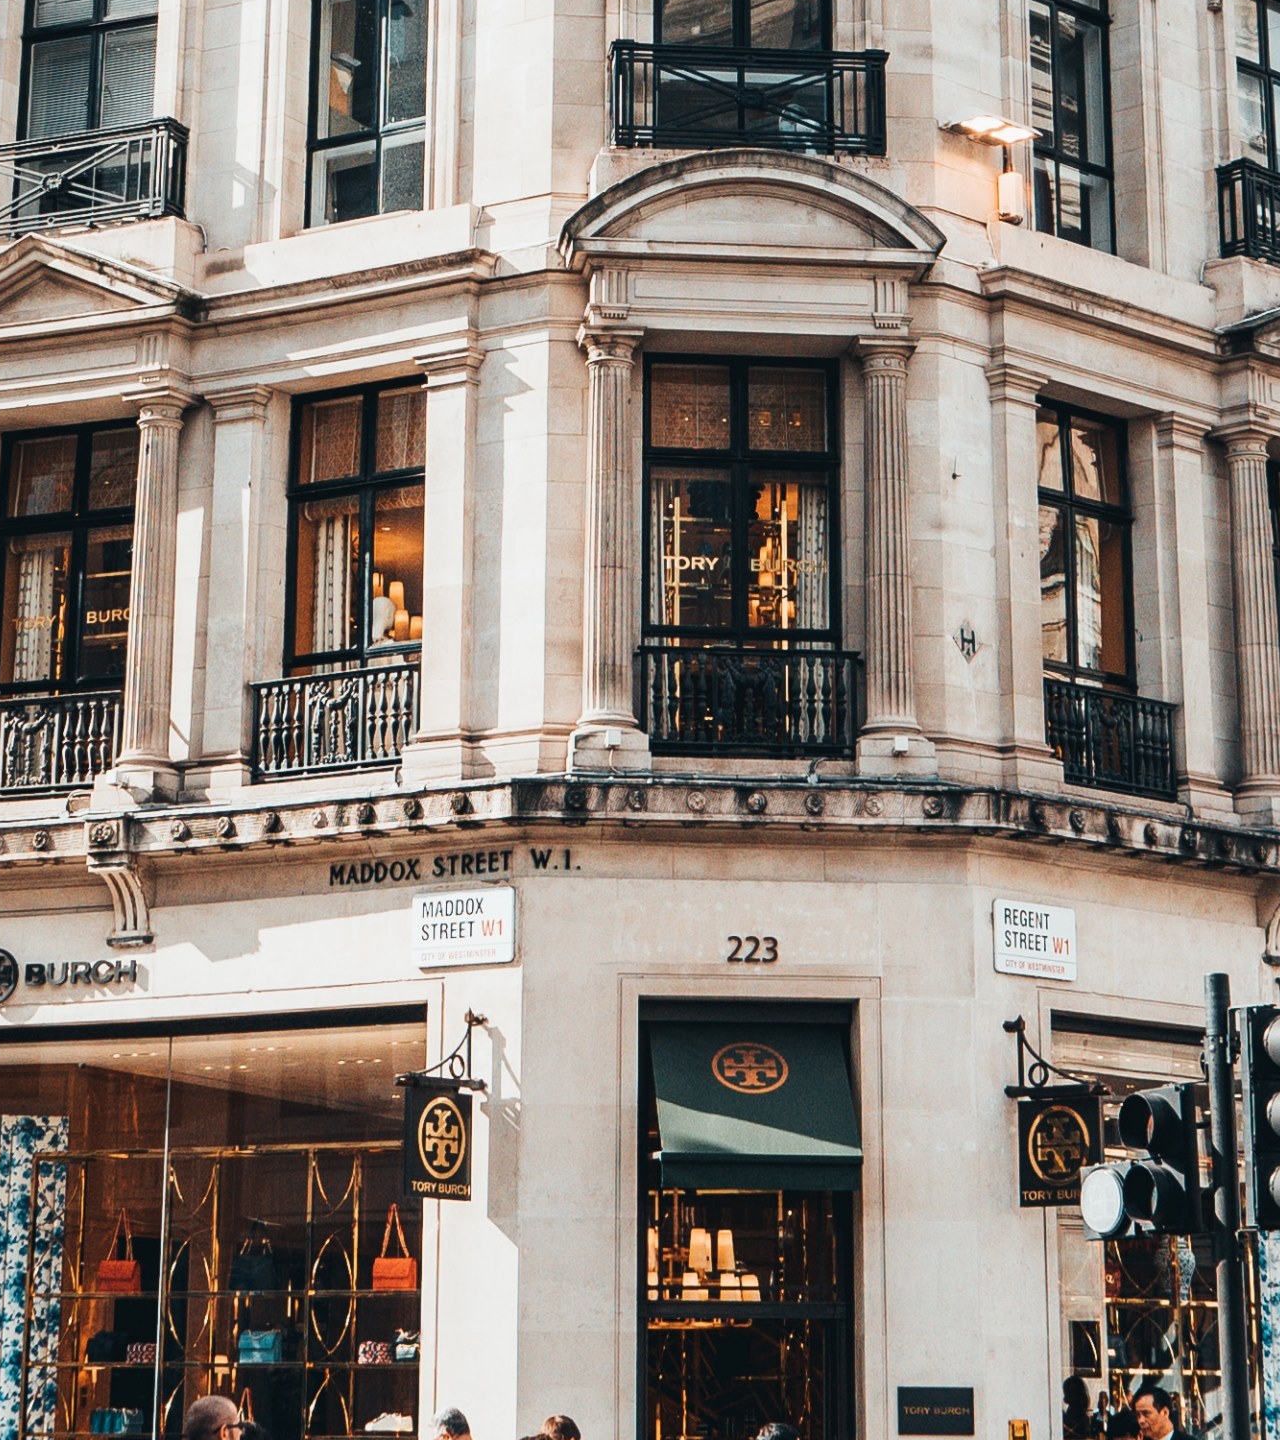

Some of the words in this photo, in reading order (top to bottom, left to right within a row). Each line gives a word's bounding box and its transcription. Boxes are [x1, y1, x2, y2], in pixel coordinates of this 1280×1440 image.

[660, 555, 719, 570] TORY
[86, 607, 131, 624] BURC
[329, 858, 420, 886] MADDOX
[432, 850, 513, 878] STREET
[422, 897, 484, 919] MADDOX
[1004, 907, 1050, 930] REGENT
[421, 920, 475, 941] STREET
[481, 919, 504, 937] W1
[727, 935, 779, 963] 223
[1004, 929, 1048, 952] STREET
[1052, 935, 1070, 955] W1
[421, 952, 436, 962] CITY
[448, 947, 497, 960] WESTMINSTER
[25, 959, 138, 987] BURCH
[1005, 959, 1017, 968] CITY
[1027, 962, 1066, 975] WESTMINSTER
[412, 1181, 437, 1193] TORY
[438, 1183, 471, 1196] BURCH
[1022, 1190, 1052, 1201] TORY
[903, 1407, 930, 1415] TORY
[933, 1407, 970, 1415] BURCH
